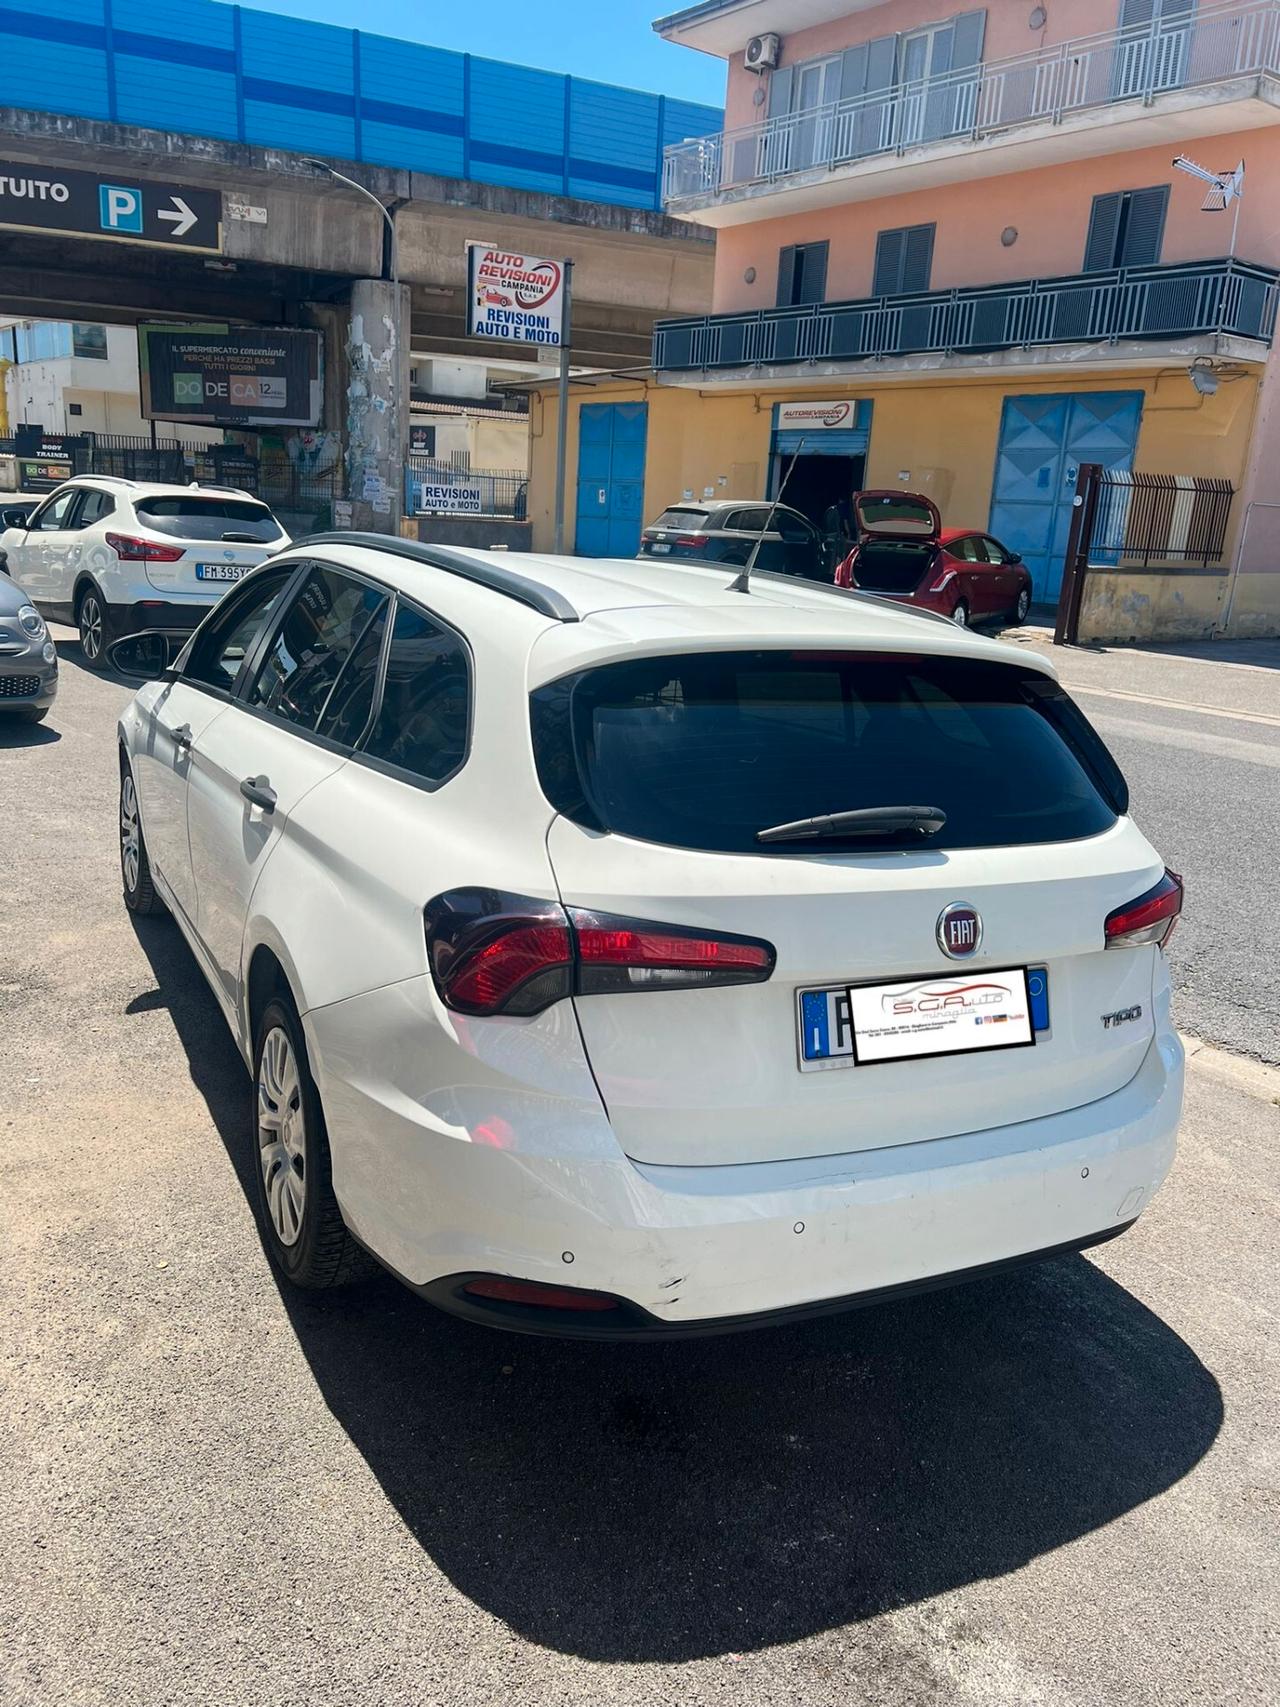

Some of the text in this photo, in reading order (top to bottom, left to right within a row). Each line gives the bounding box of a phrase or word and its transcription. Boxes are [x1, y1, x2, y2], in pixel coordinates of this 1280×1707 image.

[107, 190, 136, 226] P
[483, 252, 523, 267] AUTO
[479, 264, 552, 286] REVISIONI
[501, 280, 544, 294] CAMPANIA
[487, 308, 550, 329] REVISIONI
[476, 321, 559, 344] AUTO E MOTO
[180, 345, 238, 354] SUPERMERCATO
[425, 486, 480, 500] REVISIONI
[425, 499, 448, 508] AUTO
[458, 501, 480, 509] MOTO
[950, 919, 975, 945] FIAT
[1100, 1005, 1142, 1029] TIPO
